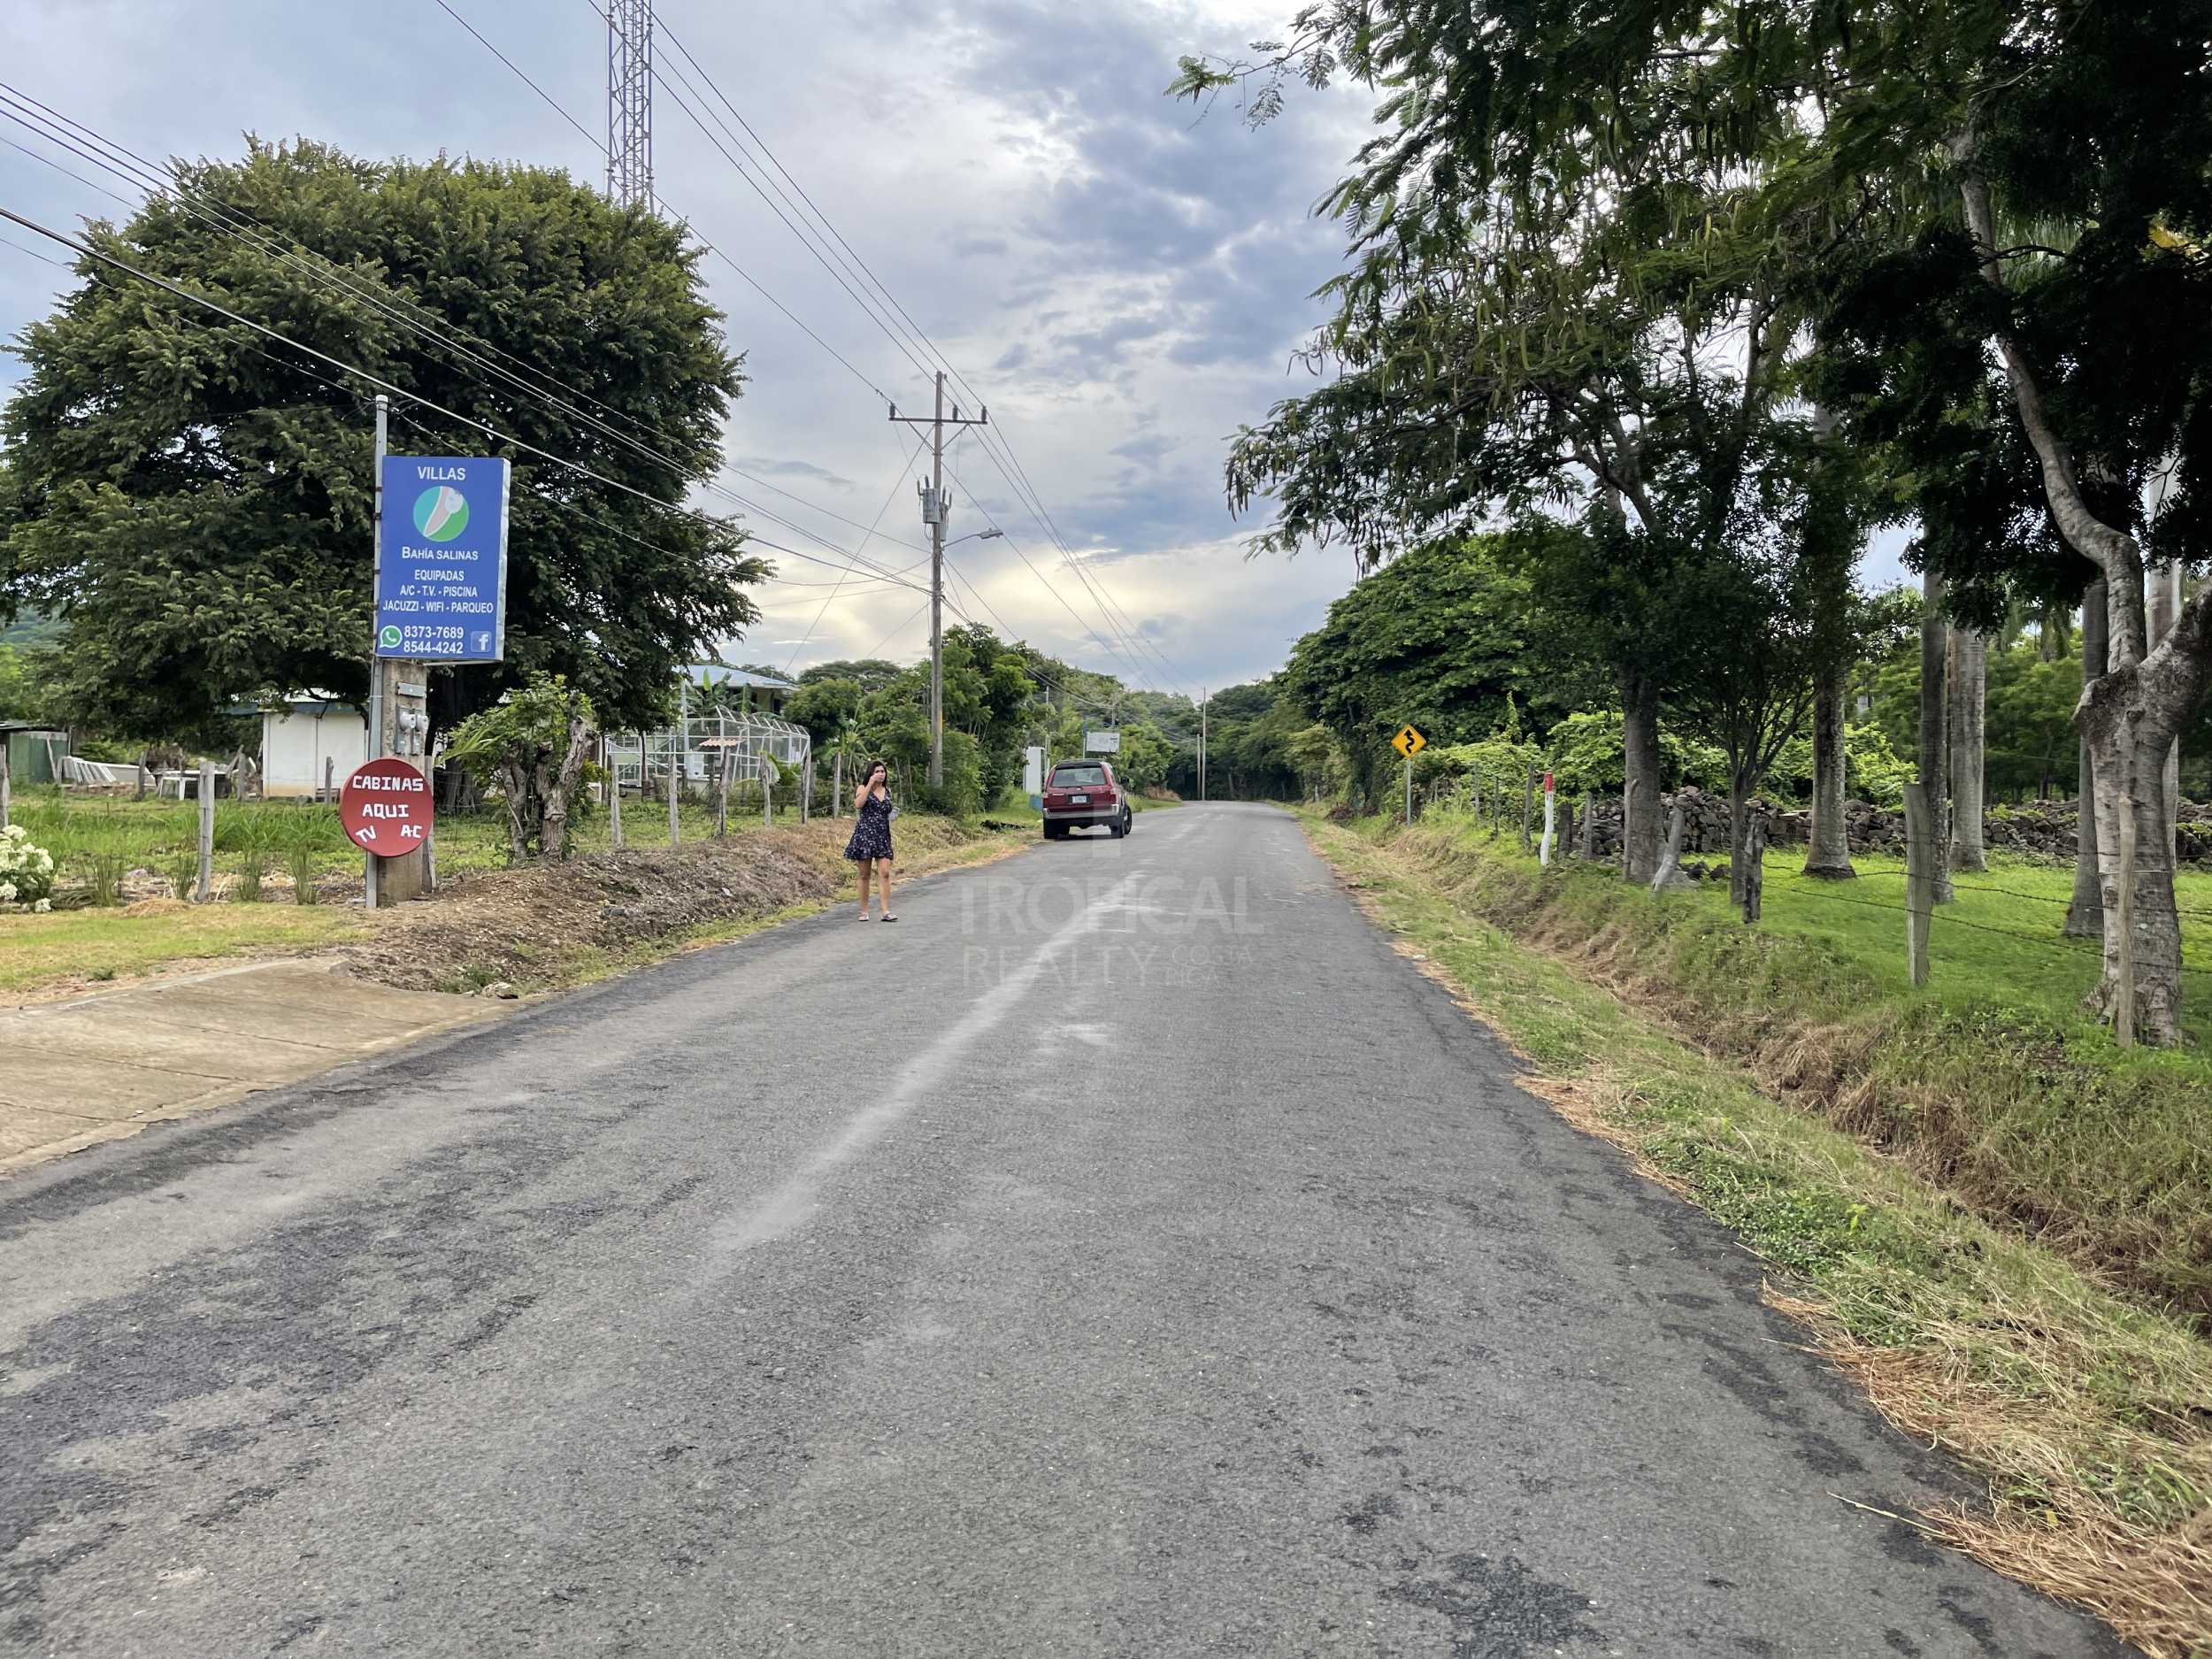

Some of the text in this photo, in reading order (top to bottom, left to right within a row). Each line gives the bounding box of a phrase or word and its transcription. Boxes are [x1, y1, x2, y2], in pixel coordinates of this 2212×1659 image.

[417, 465, 466, 480] VILLAS
[436, 550, 479, 561] SALINAS
[414, 569, 465, 581] EQUIPADAS
[400, 585, 415, 596] A/C
[443, 586, 478, 597] PISCINA
[382, 600, 419, 612] JACUZZI
[426, 601, 444, 613] WIFI
[450, 602, 494, 614] PARQUEO
[403, 626, 465, 639] 8373-7689
[403, 641, 464, 655] 8544-4242
[352, 775, 424, 792] CABINAS
[362, 803, 410, 819] AQUI
[355, 825, 377, 843] TV
